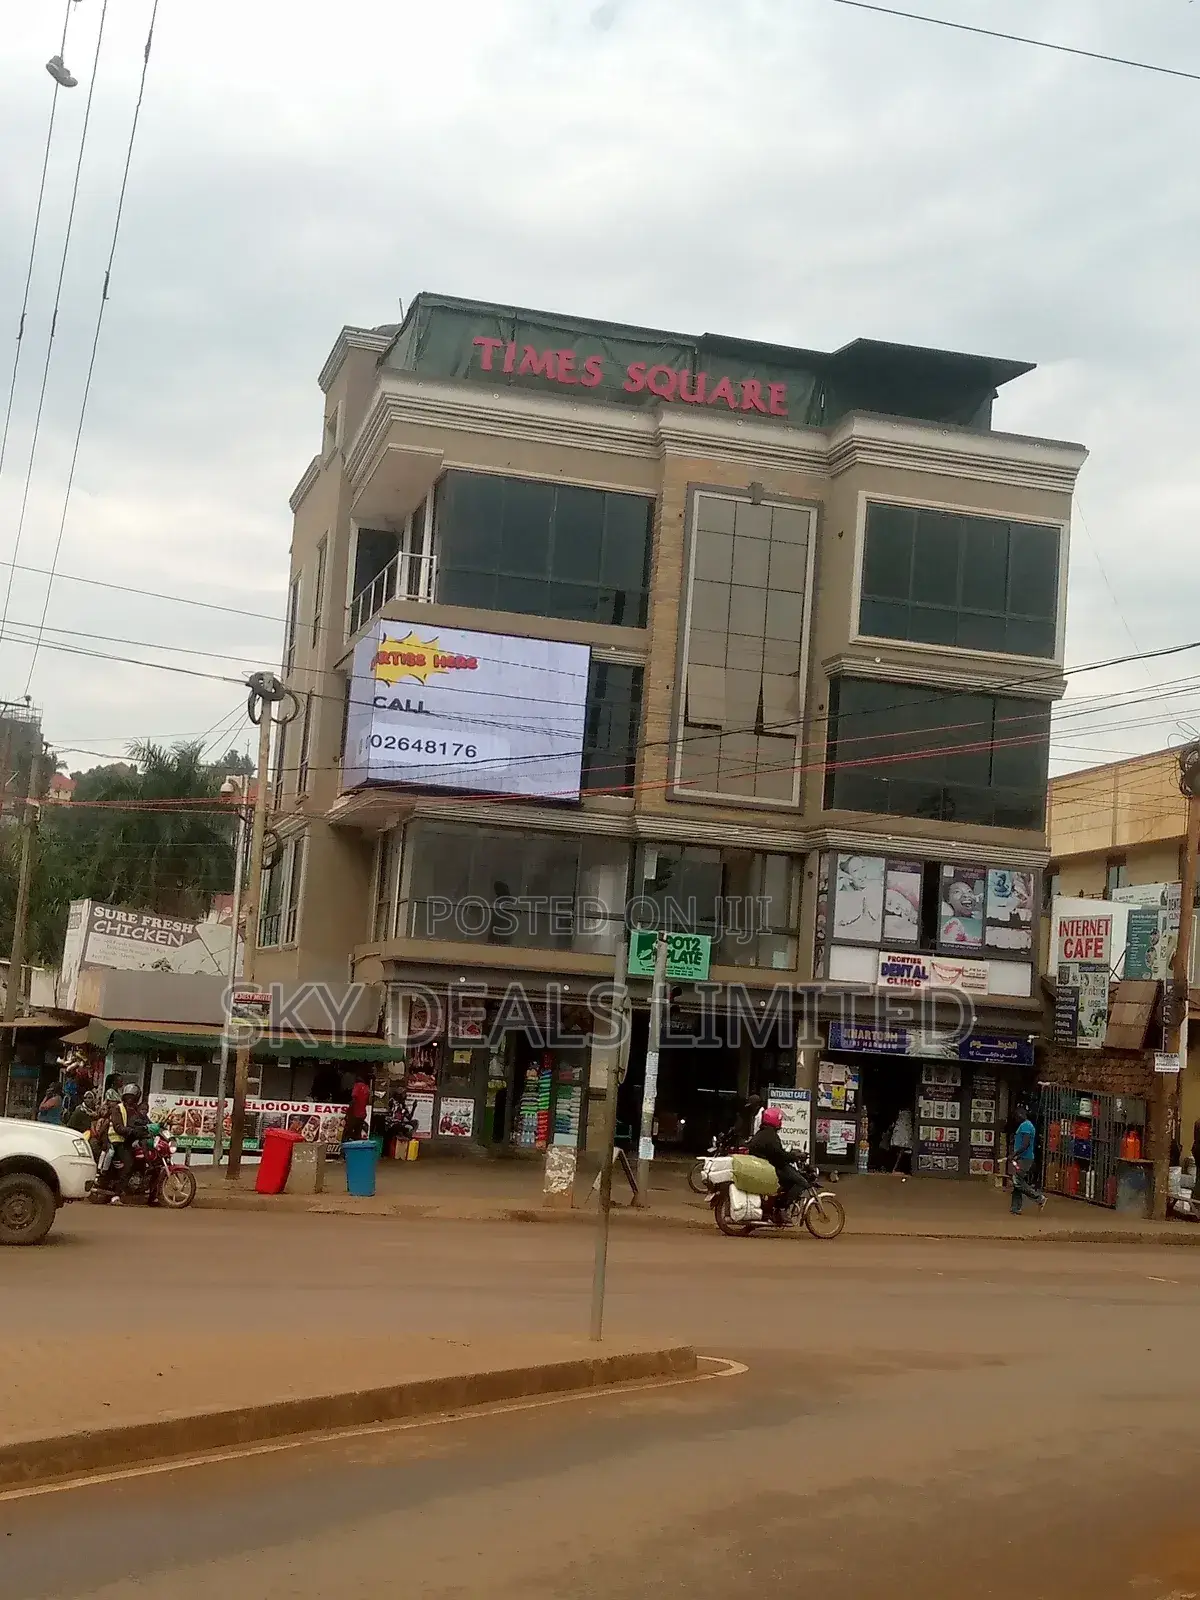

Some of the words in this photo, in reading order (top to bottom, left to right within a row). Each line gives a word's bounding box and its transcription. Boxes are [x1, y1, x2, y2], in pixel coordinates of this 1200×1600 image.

[473, 336, 602, 388] TIMES
[623, 361, 789, 416] SQUARE
[373, 696, 431, 714] CALL
[93, 906, 138, 924] SURE
[141, 915, 195, 934] FRESH
[1059, 919, 1110, 937] INTERNET
[93, 920, 184, 947] CHICKEN
[1064, 937, 1104, 958] CAFE
[887, 955, 922, 965] FRONTIER
[881, 962, 929, 980] DENTAL
[887, 977, 921, 987] CLINIC
[770, 1090, 794, 1099] INTERNET
[794, 1091, 807, 1099] CAFE
[175, 1096, 229, 1109] JULIUS
[244, 1098, 309, 1113] ELICIOUS
[315, 1104, 349, 1115] EATS
